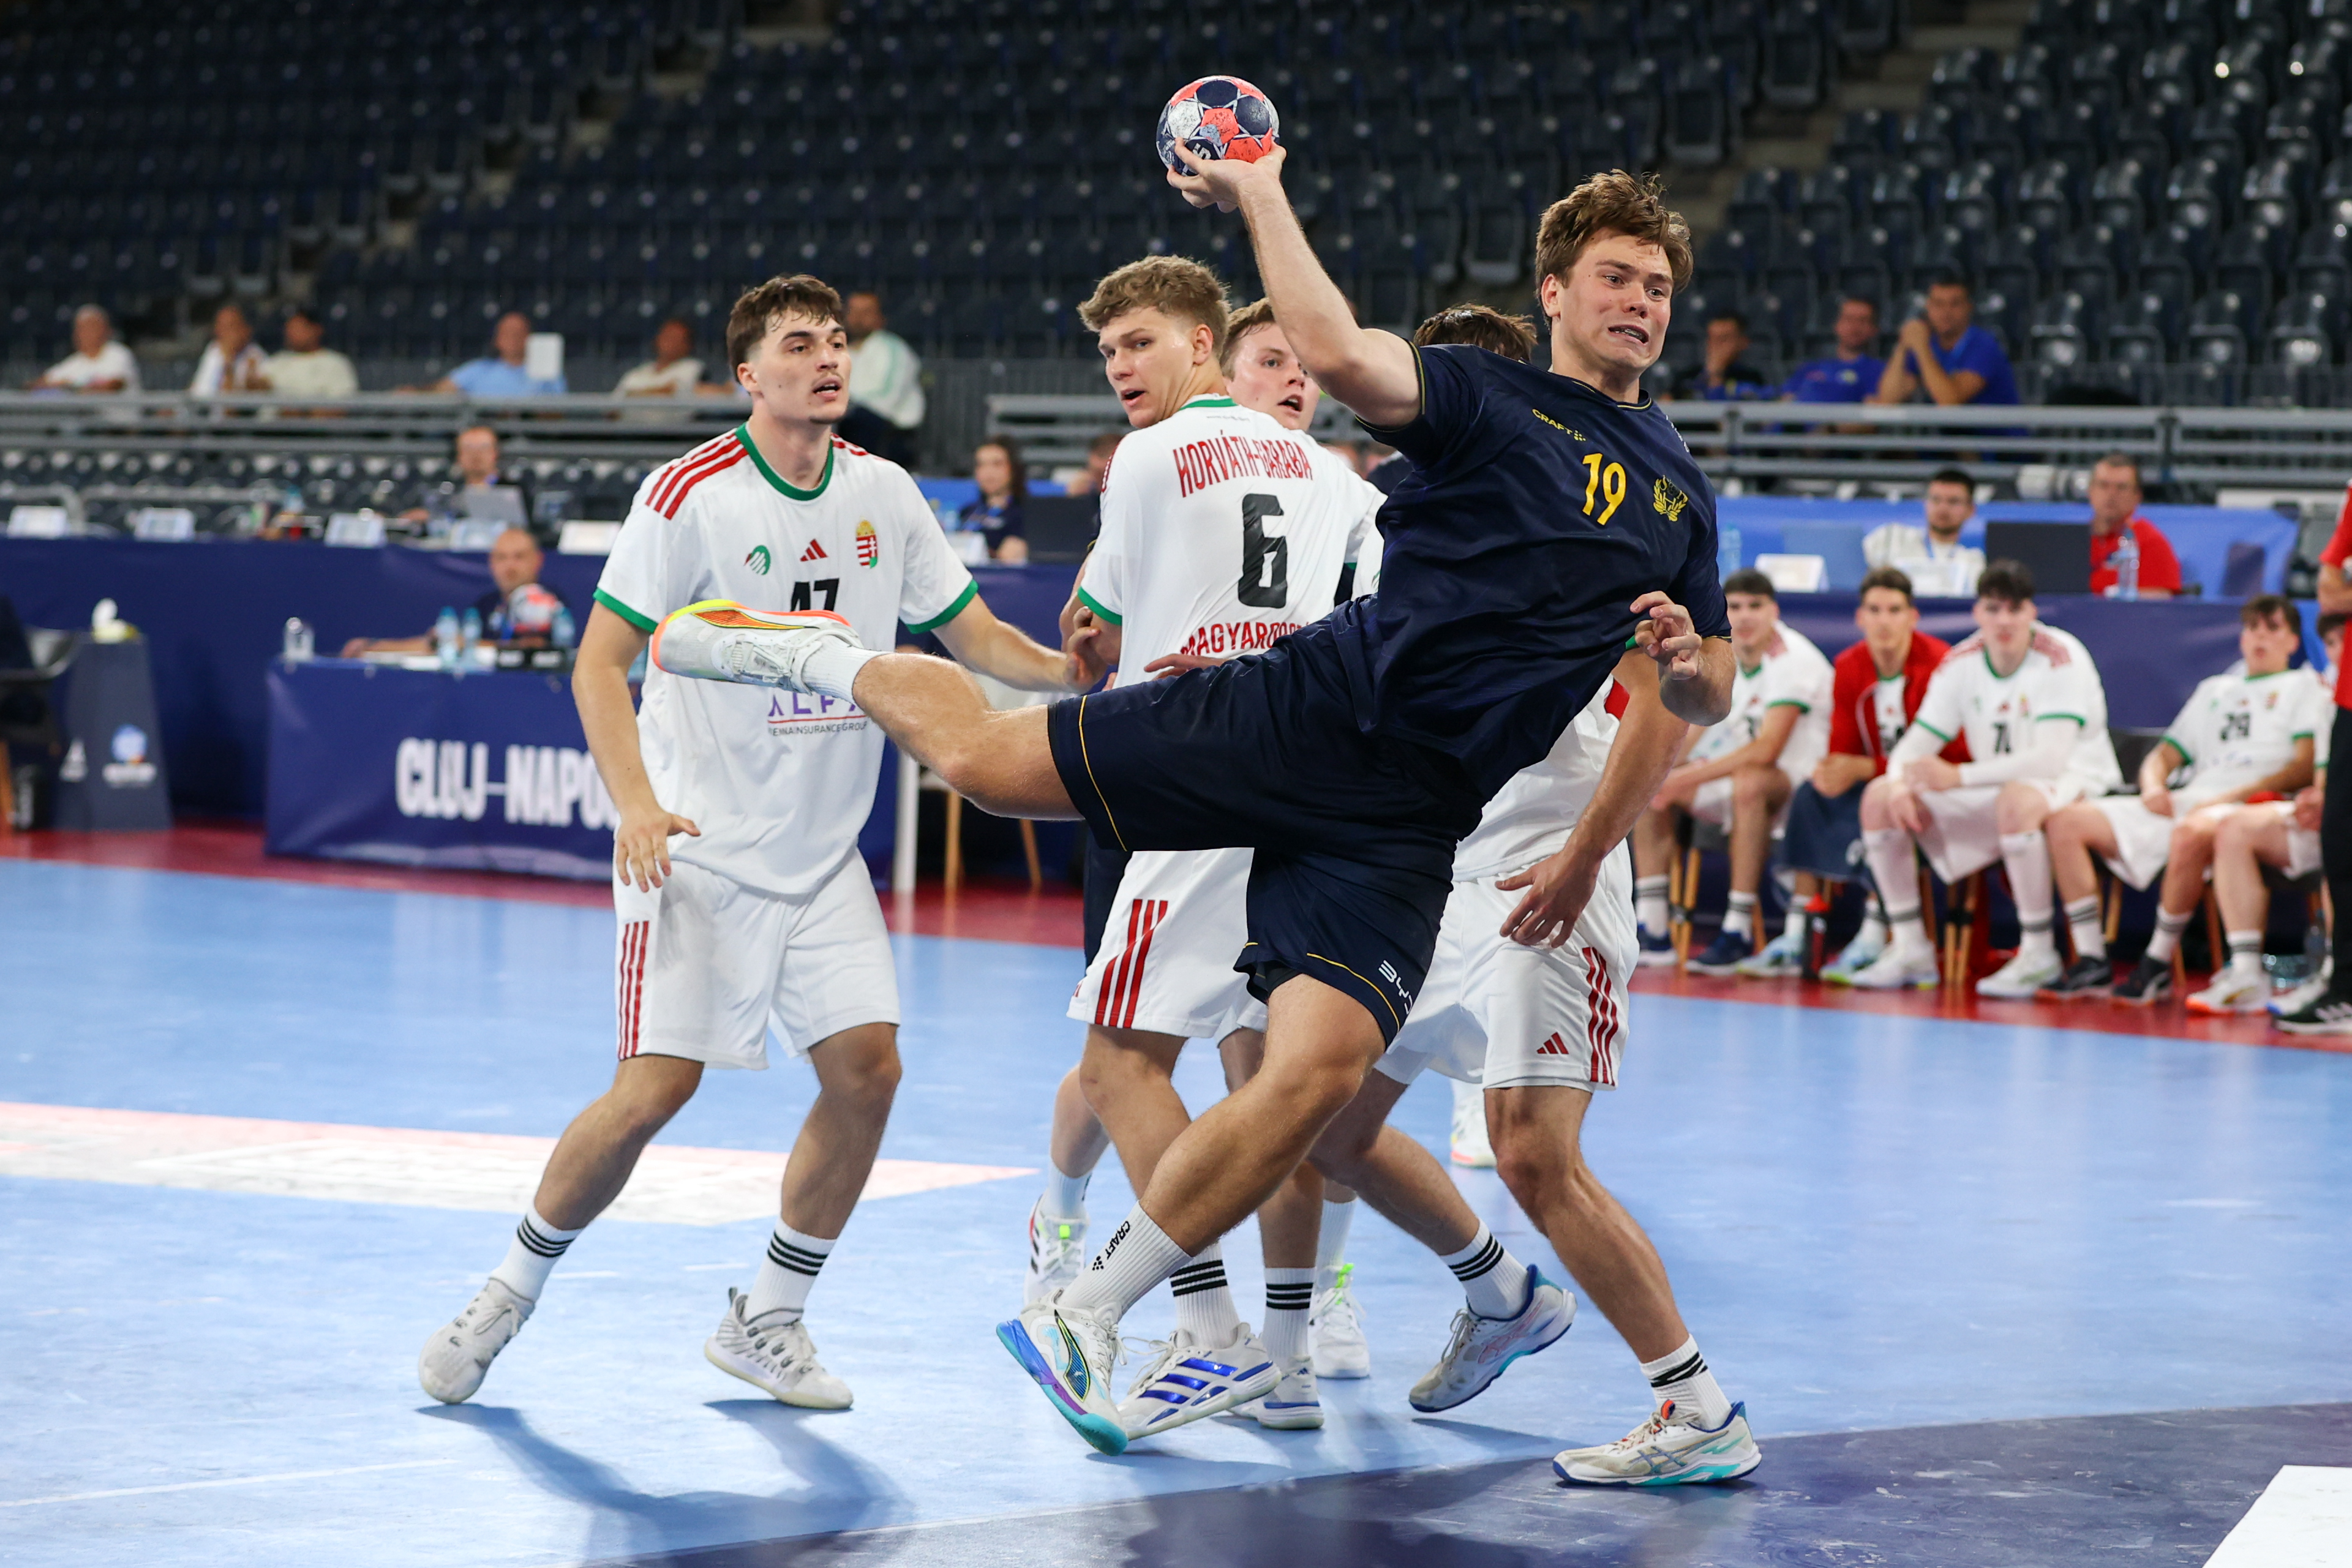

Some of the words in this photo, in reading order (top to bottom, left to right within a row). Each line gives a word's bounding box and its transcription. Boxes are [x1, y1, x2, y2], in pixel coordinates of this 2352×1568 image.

[1532, 408, 1572, 435] CRAFT
[1582, 452, 1626, 525] 19
[1238, 493, 1288, 609] 6
[1181, 621, 1309, 656] MAGYARO
[768, 692, 856, 717] ALF
[396, 737, 615, 830] CLUJ-NAPO
[1105, 1220, 1131, 1259] CRAFT
